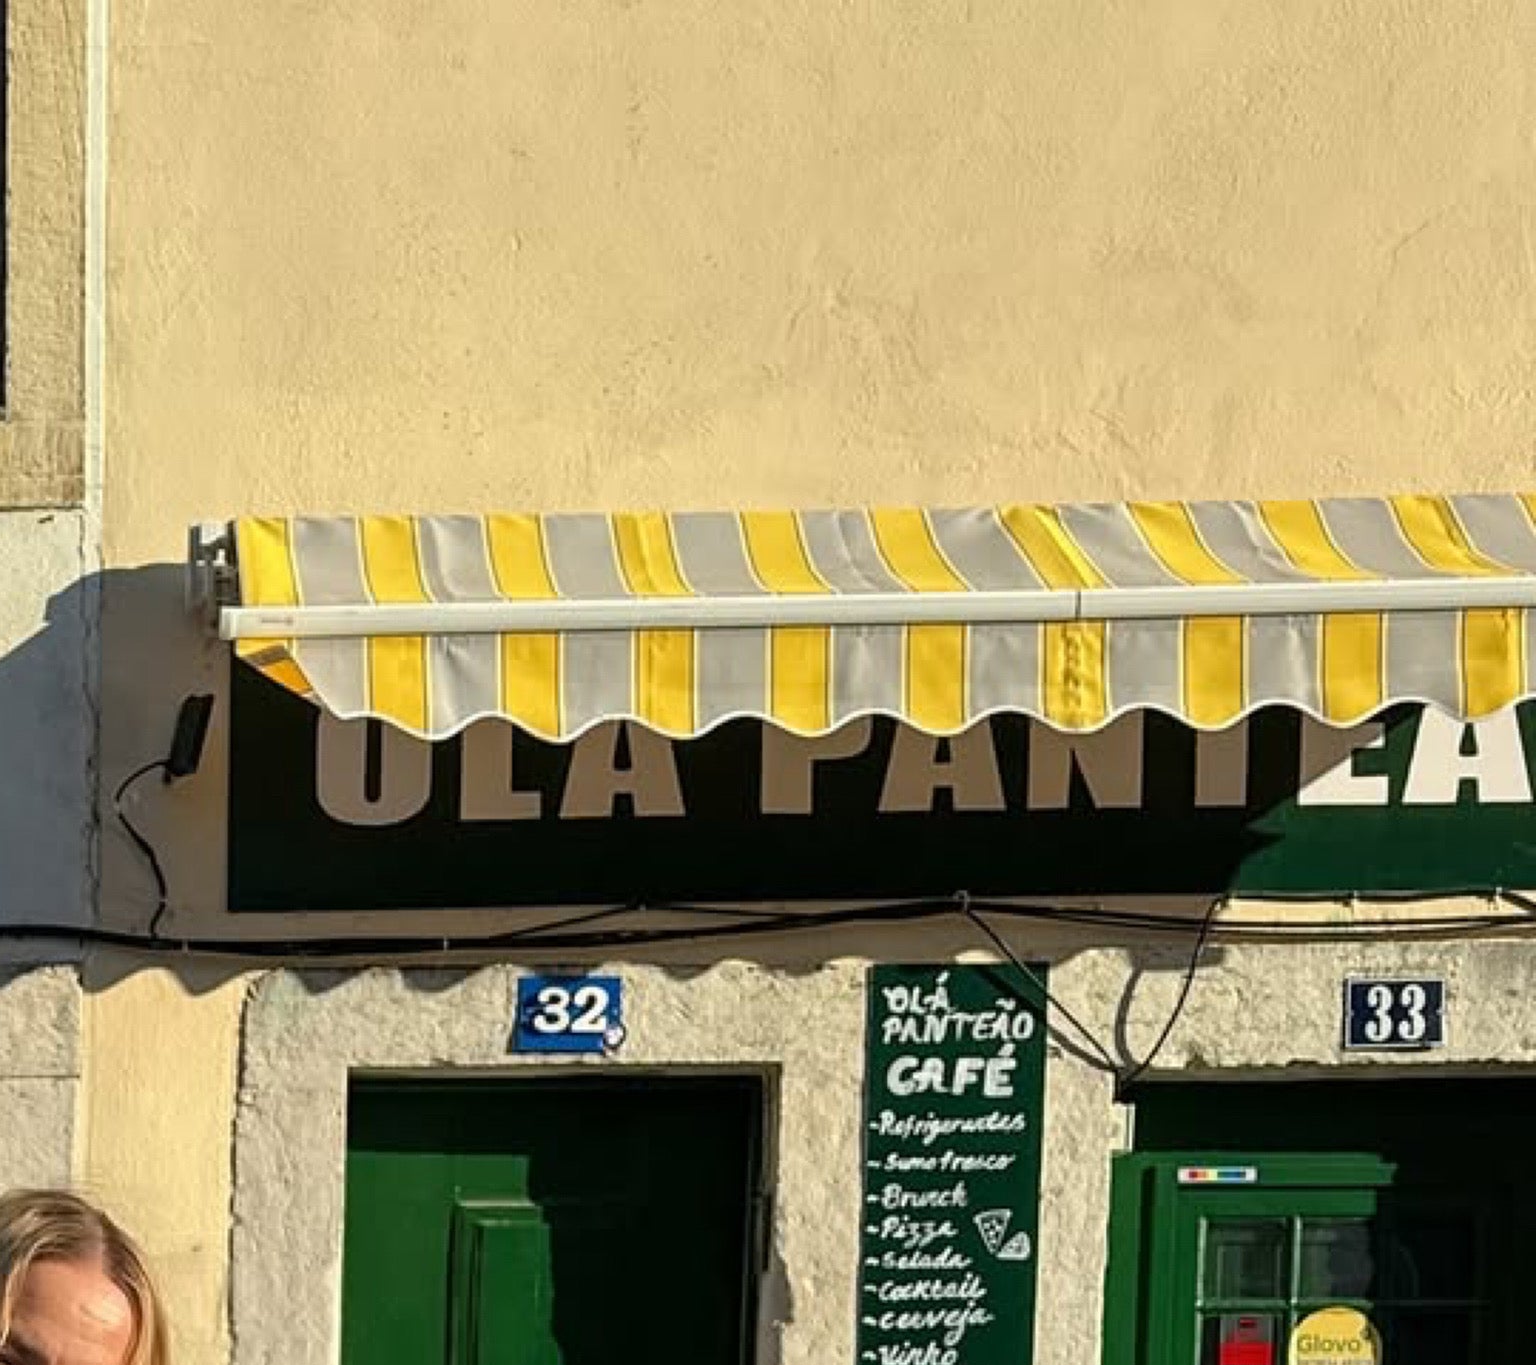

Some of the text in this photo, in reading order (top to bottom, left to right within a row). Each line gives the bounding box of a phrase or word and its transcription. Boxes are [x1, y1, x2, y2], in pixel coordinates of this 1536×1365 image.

[533, 986, 610, 1033] 32
[881, 970, 956, 1014] OLÁ
[1364, 983, 1426, 1042] 33
[881, 997, 1035, 1044] PANTEÃO
[886, 1042, 1018, 1097] CAFÉ
[1296, 1332, 1361, 1354] Glovo
